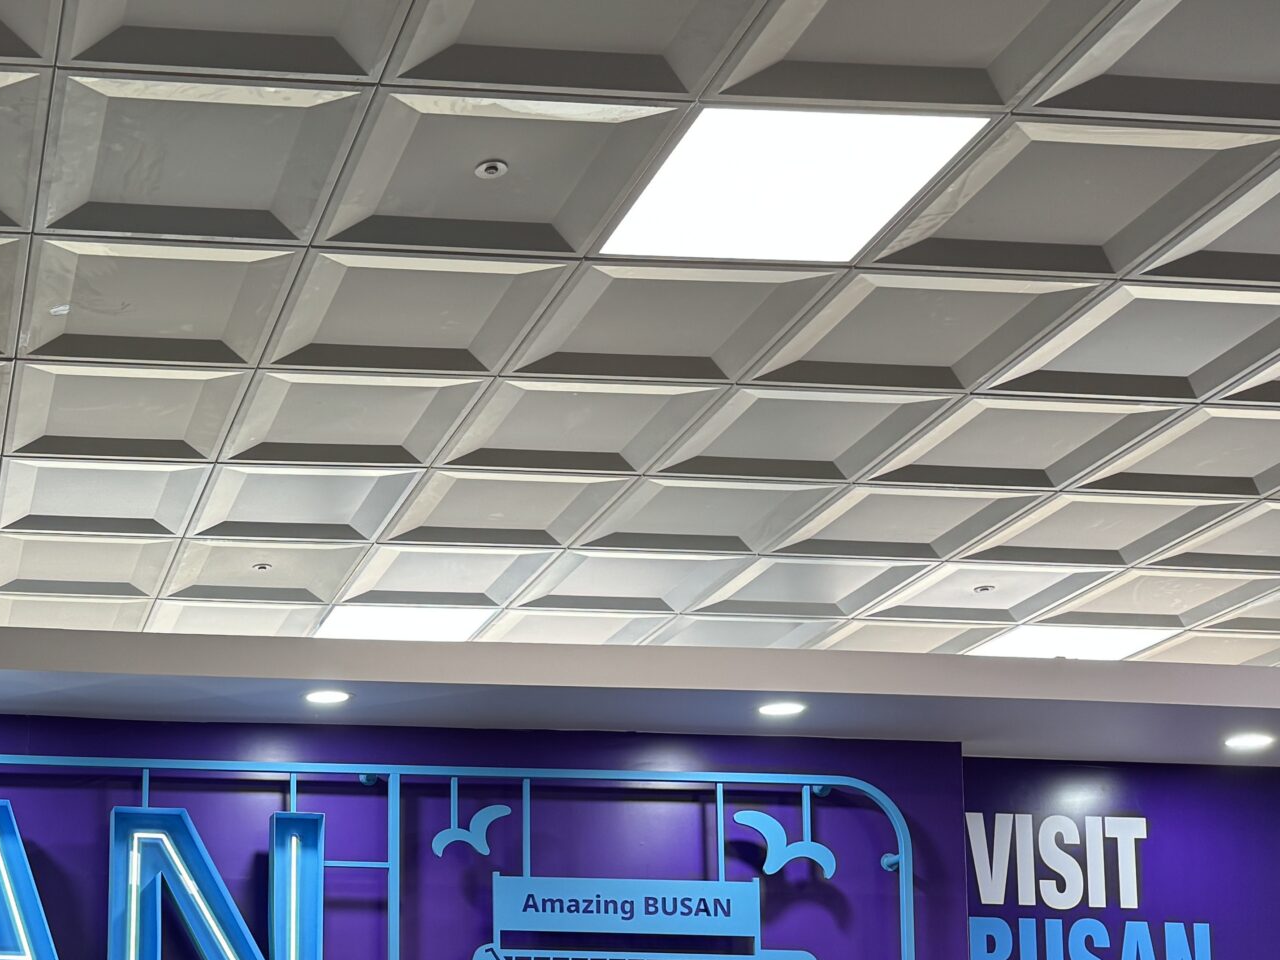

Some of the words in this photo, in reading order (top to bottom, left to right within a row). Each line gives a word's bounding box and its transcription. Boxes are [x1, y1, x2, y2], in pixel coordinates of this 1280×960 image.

[965, 812, 1148, 910] VISIT
[522, 893, 635, 920] Amazing
[643, 896, 732, 918] BUSAN
